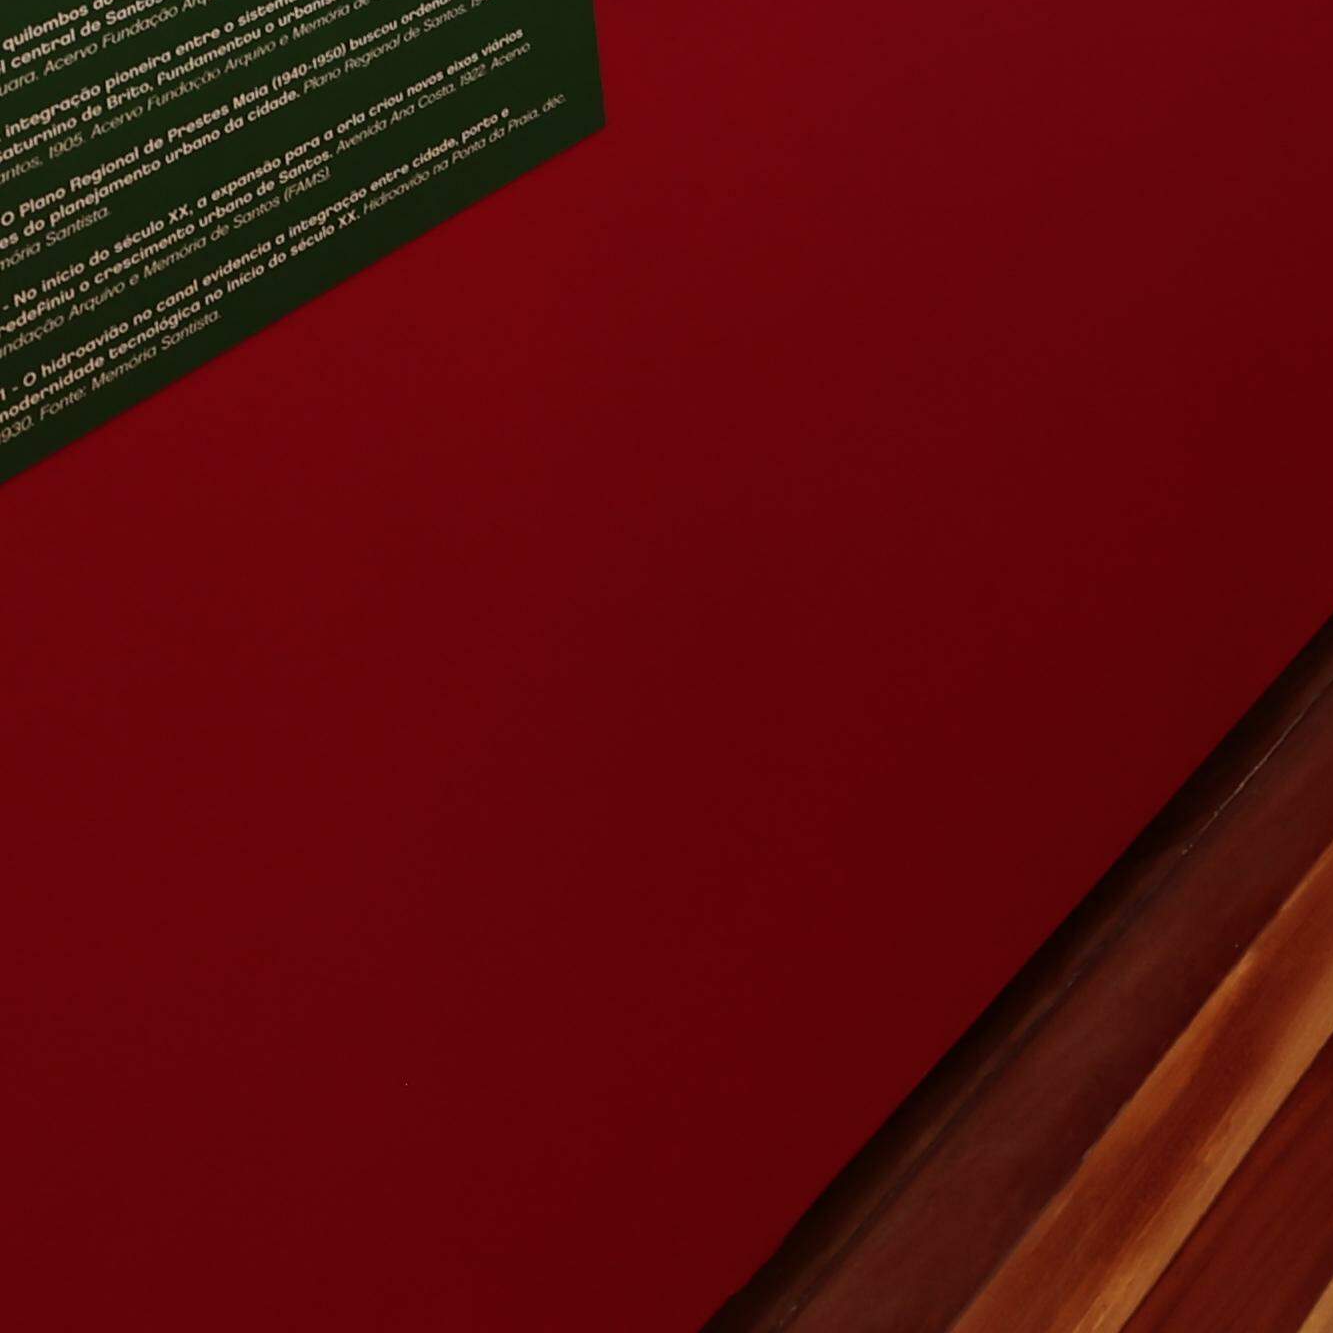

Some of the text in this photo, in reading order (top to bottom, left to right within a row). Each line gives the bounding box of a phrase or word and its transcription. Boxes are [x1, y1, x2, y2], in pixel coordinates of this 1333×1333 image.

[2, 4, 89, 52] quilombos
[5, 85, 101, 138] integração
[105, 51, 172, 94] pioneira
[175, 28, 221, 56] entre
[224, 21, 234, 33] o
[0, 211, 15, 227] O
[19, 187, 66, 218] Plano
[70, 146, 140, 192] Regional
[143, 138, 164, 155] de
[167, 105, 230, 143] Prestes
[232, 84, 269, 110] Maia
[272, 42, 347, 91] (1940-1950)
[349, 20, 398, 51] buscou
[23, 371, 37, 387] O
[41, 322, 129, 378] hidroavião
[133, 309, 152, 326] no
[156, 278, 199, 313] canal
[202, 241, 272, 287] evidencia
[275, 233, 285, 245] a
[288, 187, 367, 238] integração
[370, 164, 409, 191] entre
[461, 114, 499, 144] porto
[501, 107, 509, 118] e
